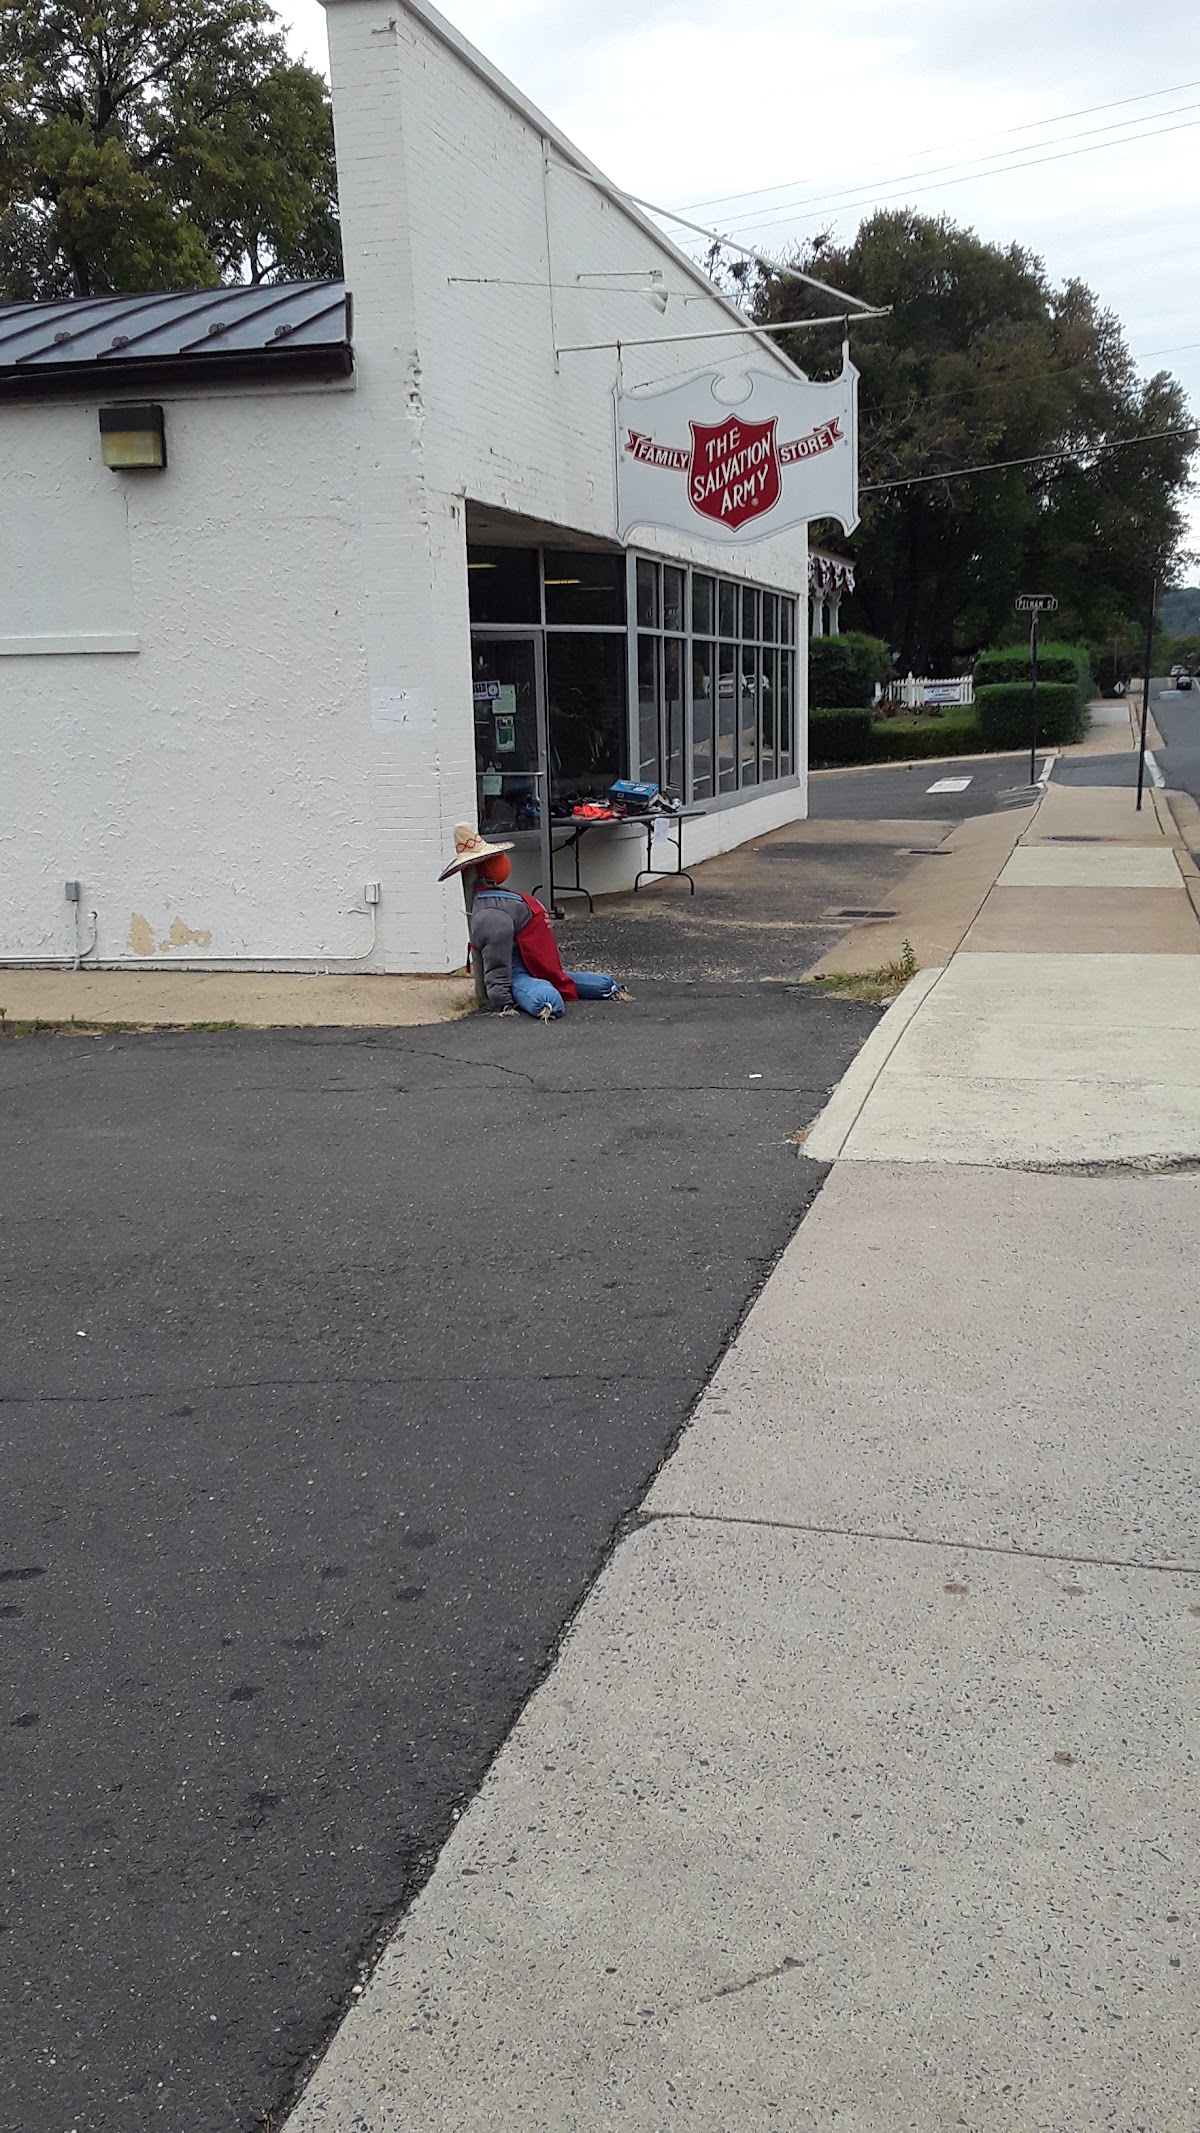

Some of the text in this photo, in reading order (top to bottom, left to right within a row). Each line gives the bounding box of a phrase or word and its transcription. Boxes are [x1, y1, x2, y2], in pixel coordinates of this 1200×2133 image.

[638, 444, 689, 469] FAMILY
[705, 426, 741, 463] THE
[780, 432, 829, 462] STORE
[693, 431, 771, 502] SALVATION
[720, 463, 769, 517] ARMY
